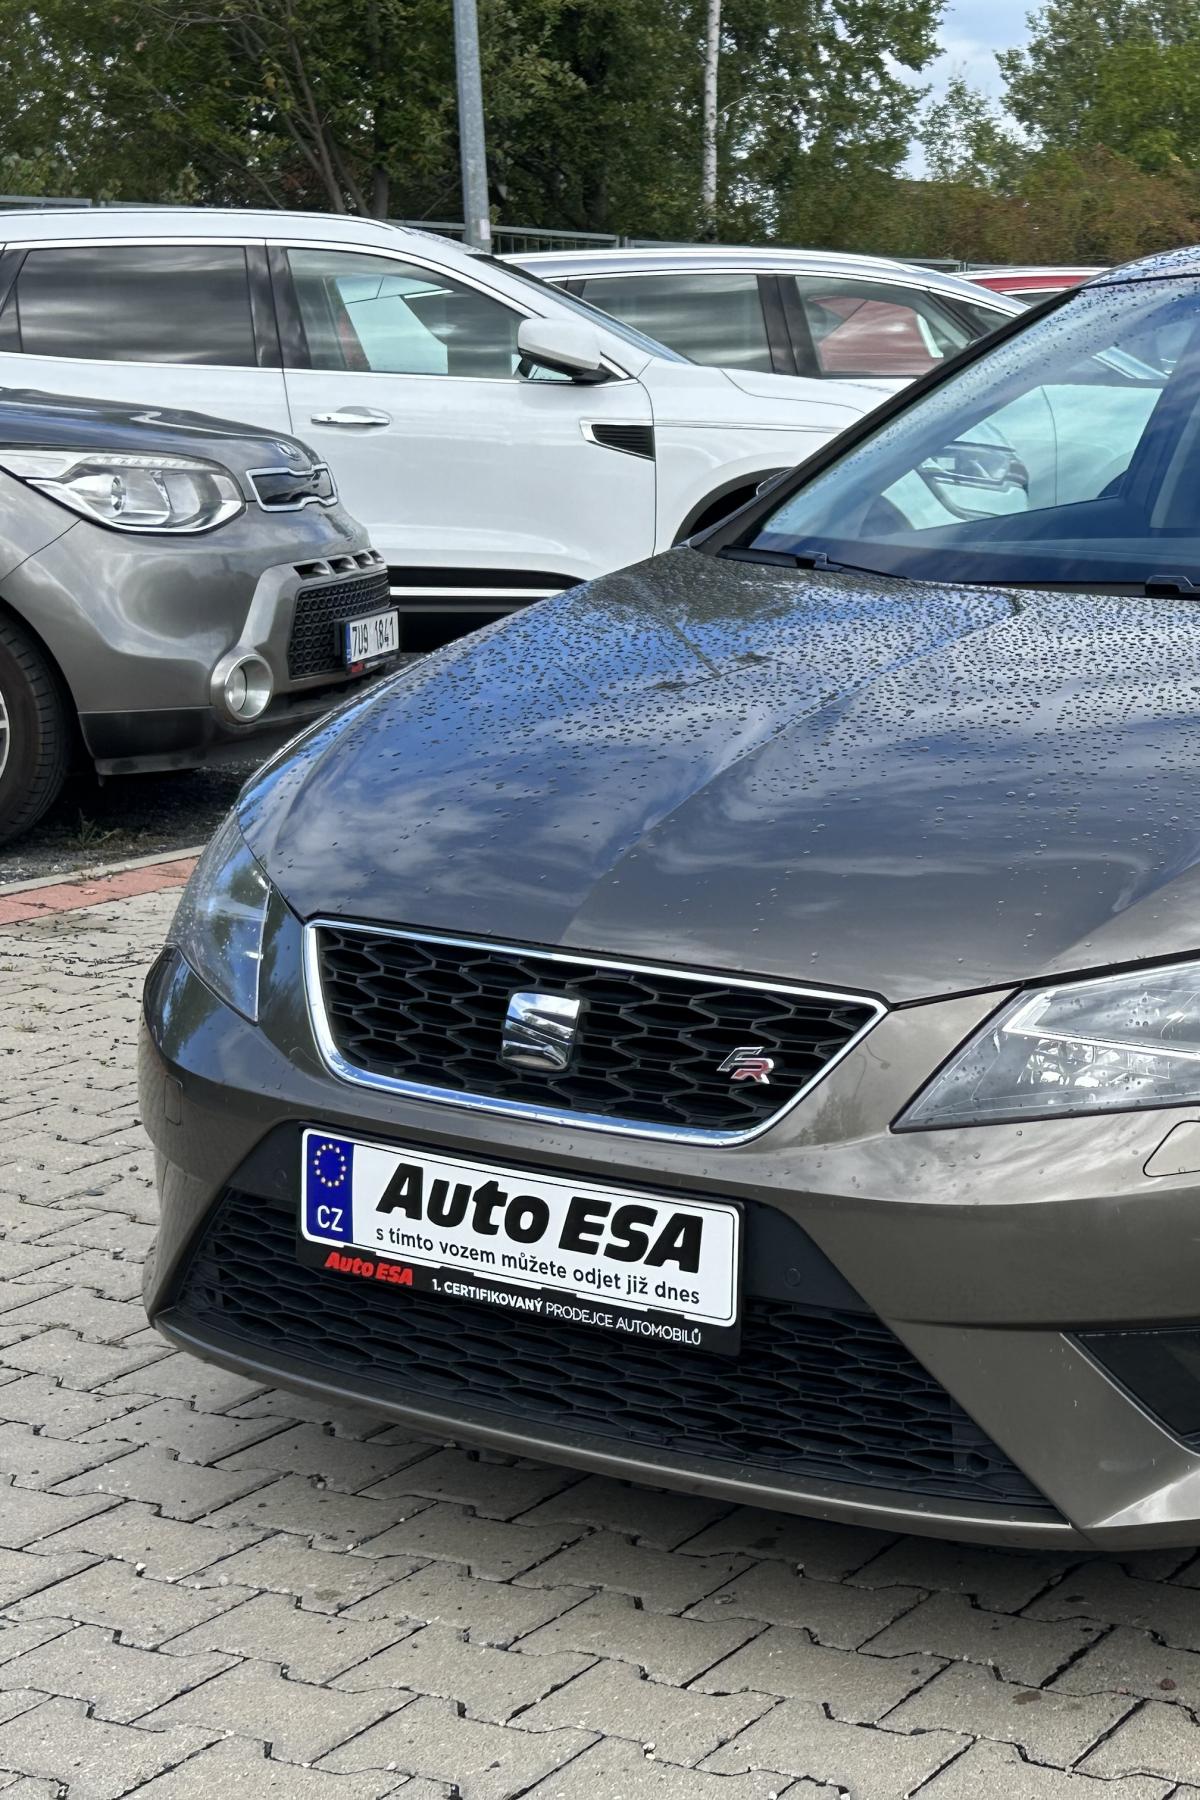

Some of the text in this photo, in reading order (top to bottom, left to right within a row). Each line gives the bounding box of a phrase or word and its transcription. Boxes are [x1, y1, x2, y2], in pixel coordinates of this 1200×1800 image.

[352, 623, 369, 656] 7U9
[716, 1046, 775, 1085] FR
[316, 1204, 344, 1232] CZ
[375, 1162, 704, 1274] Auto ESA
[325, 1251, 415, 1286] Auto ESA
[376, 1227, 700, 1305] s tímto vozem můžete odjet již dnes
[432, 1278, 702, 1346] 1. CERTIFIKOVANÝ PRODEJCE AUTOMOBILŮ
